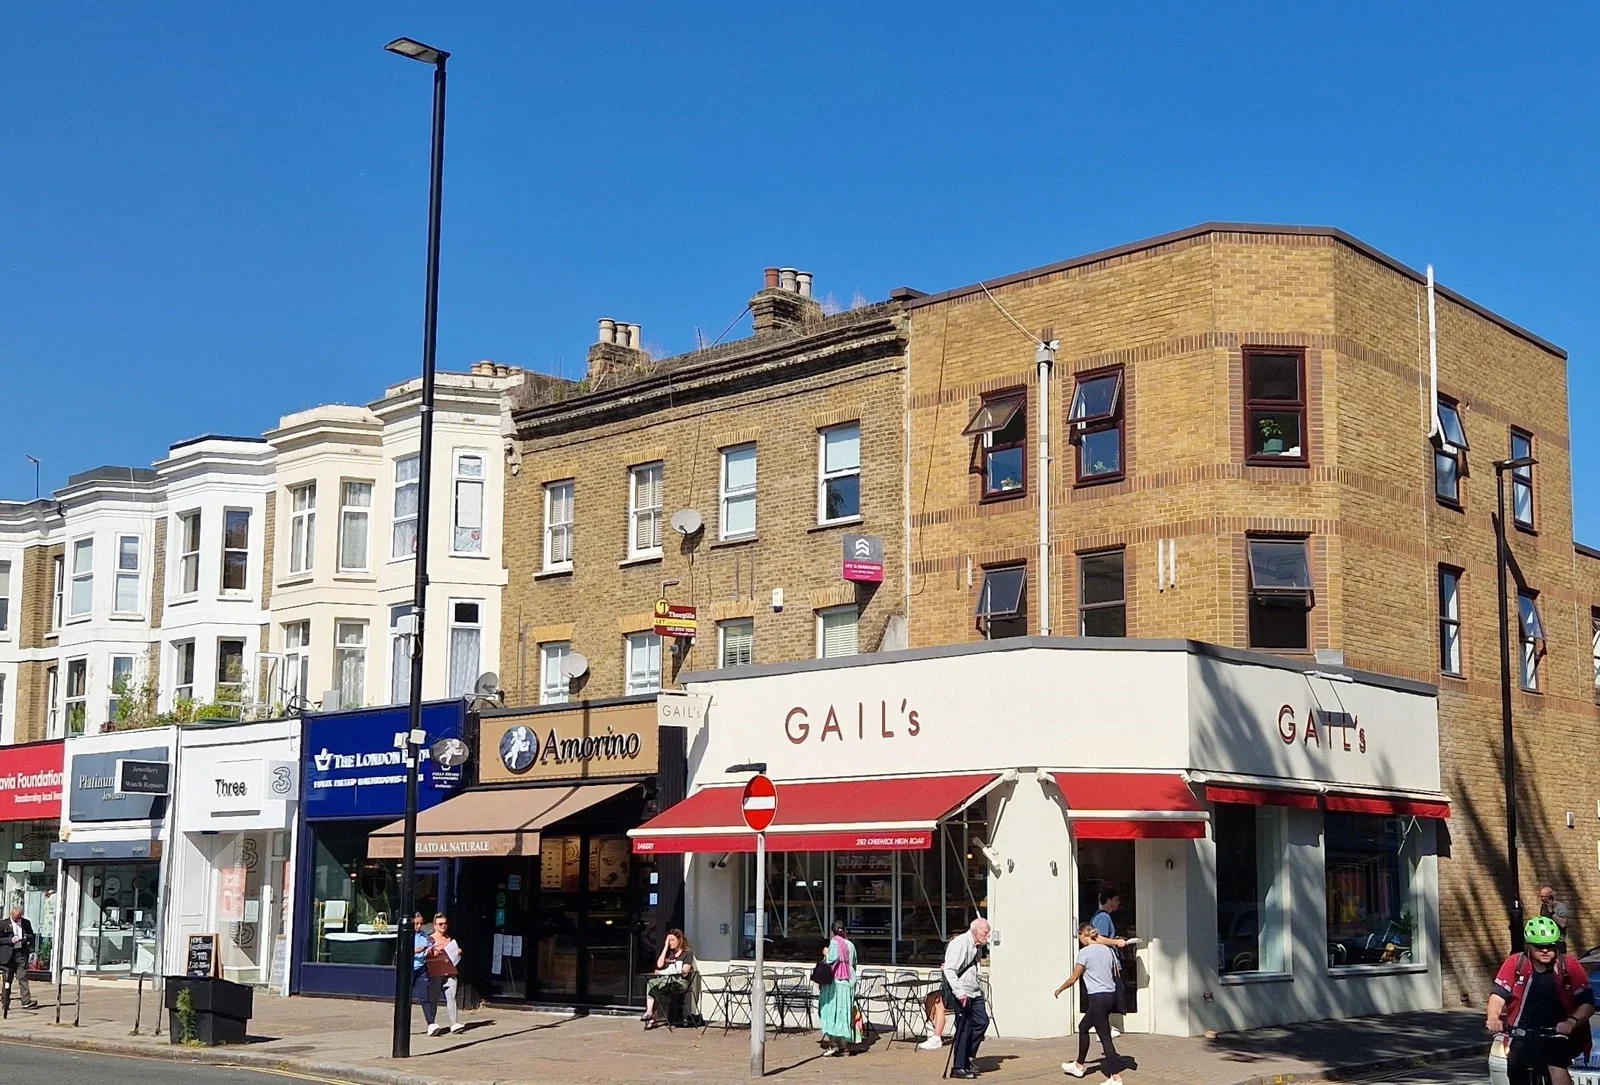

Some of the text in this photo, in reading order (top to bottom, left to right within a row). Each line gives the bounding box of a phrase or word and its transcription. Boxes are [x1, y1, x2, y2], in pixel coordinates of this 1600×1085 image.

[662, 704, 701, 718] GAIL's
[785, 698, 920, 744] GAIL's
[1278, 704, 1366, 754] GAIL's
[540, 725, 641, 762] Amorino
[333, 754, 355, 769] THE
[355, 751, 401, 767] LONDON
[17, 769, 64, 789] Foundation
[215, 779, 247, 797] Three
[438, 842, 449, 852] AL
[449, 841, 489, 852] NATURALE
